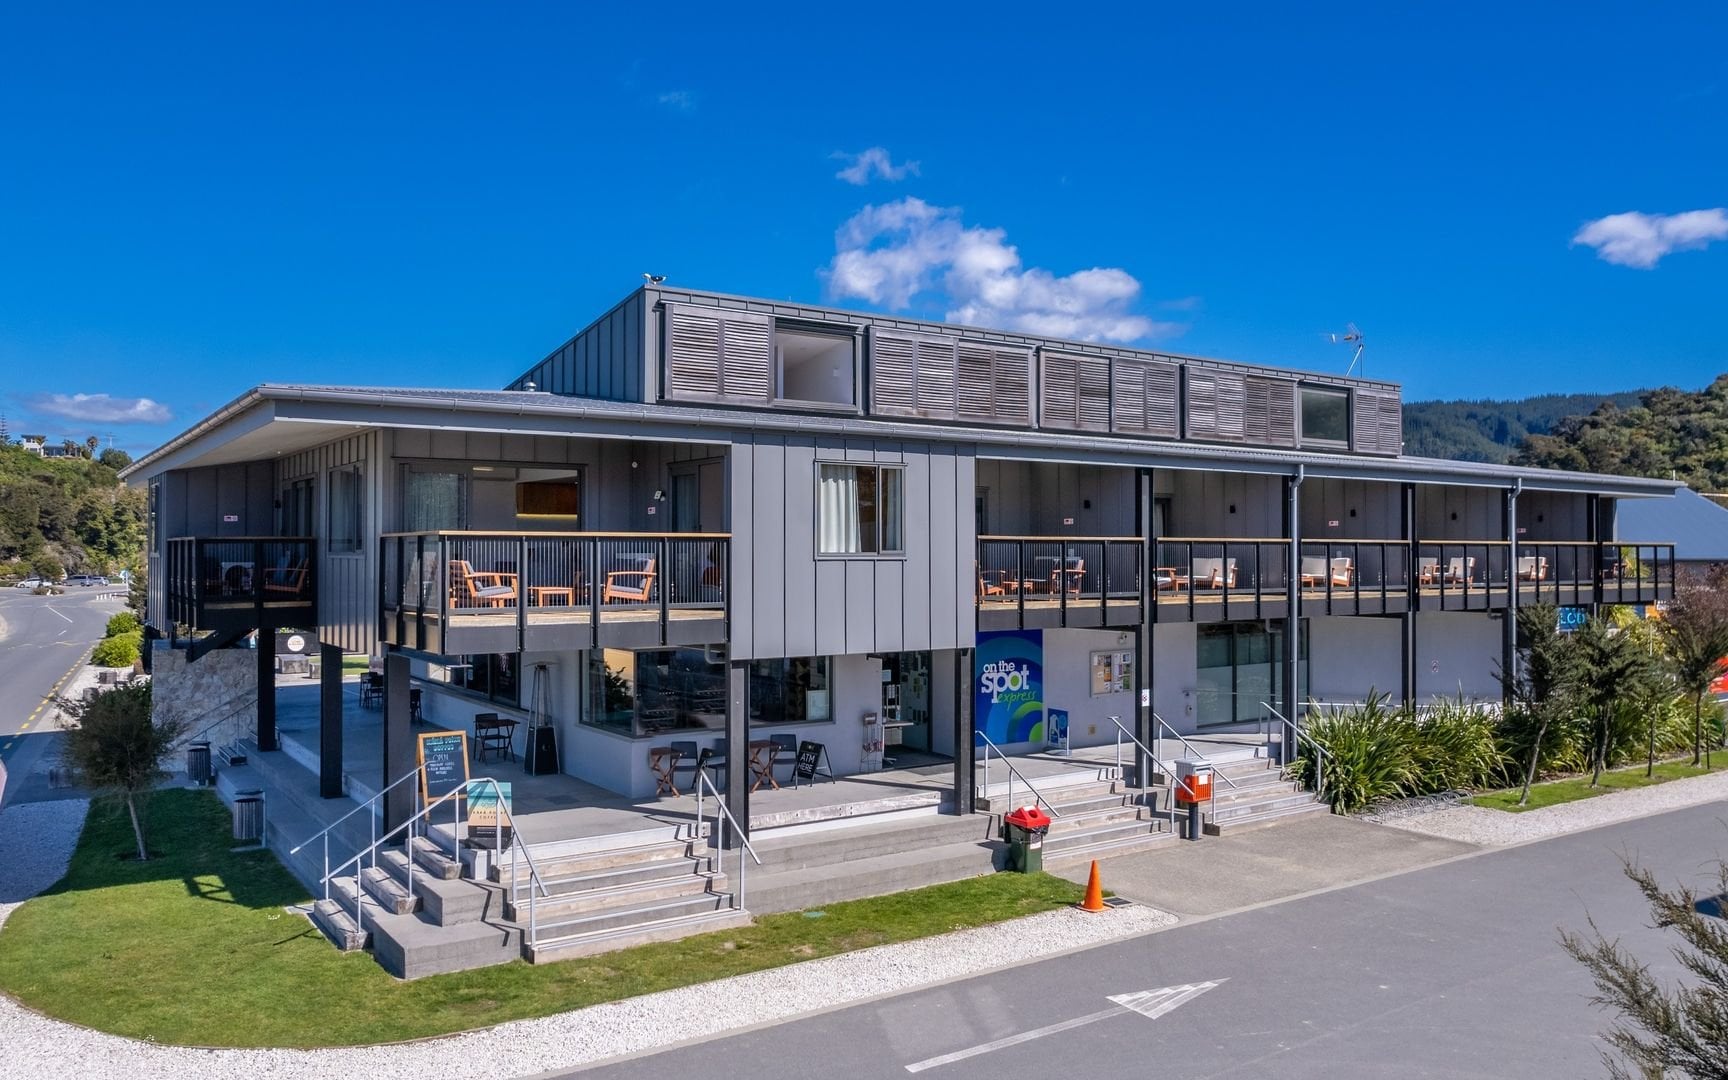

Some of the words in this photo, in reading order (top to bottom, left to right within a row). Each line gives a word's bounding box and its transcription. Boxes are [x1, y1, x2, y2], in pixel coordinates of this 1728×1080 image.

[983, 663, 997, 673] on
[998, 660, 1015, 672] the
[981, 664, 1029, 703] spot
[997, 691, 1036, 712] express
[800, 752, 816, 763] ATM
[798, 763, 813, 772] HERE
